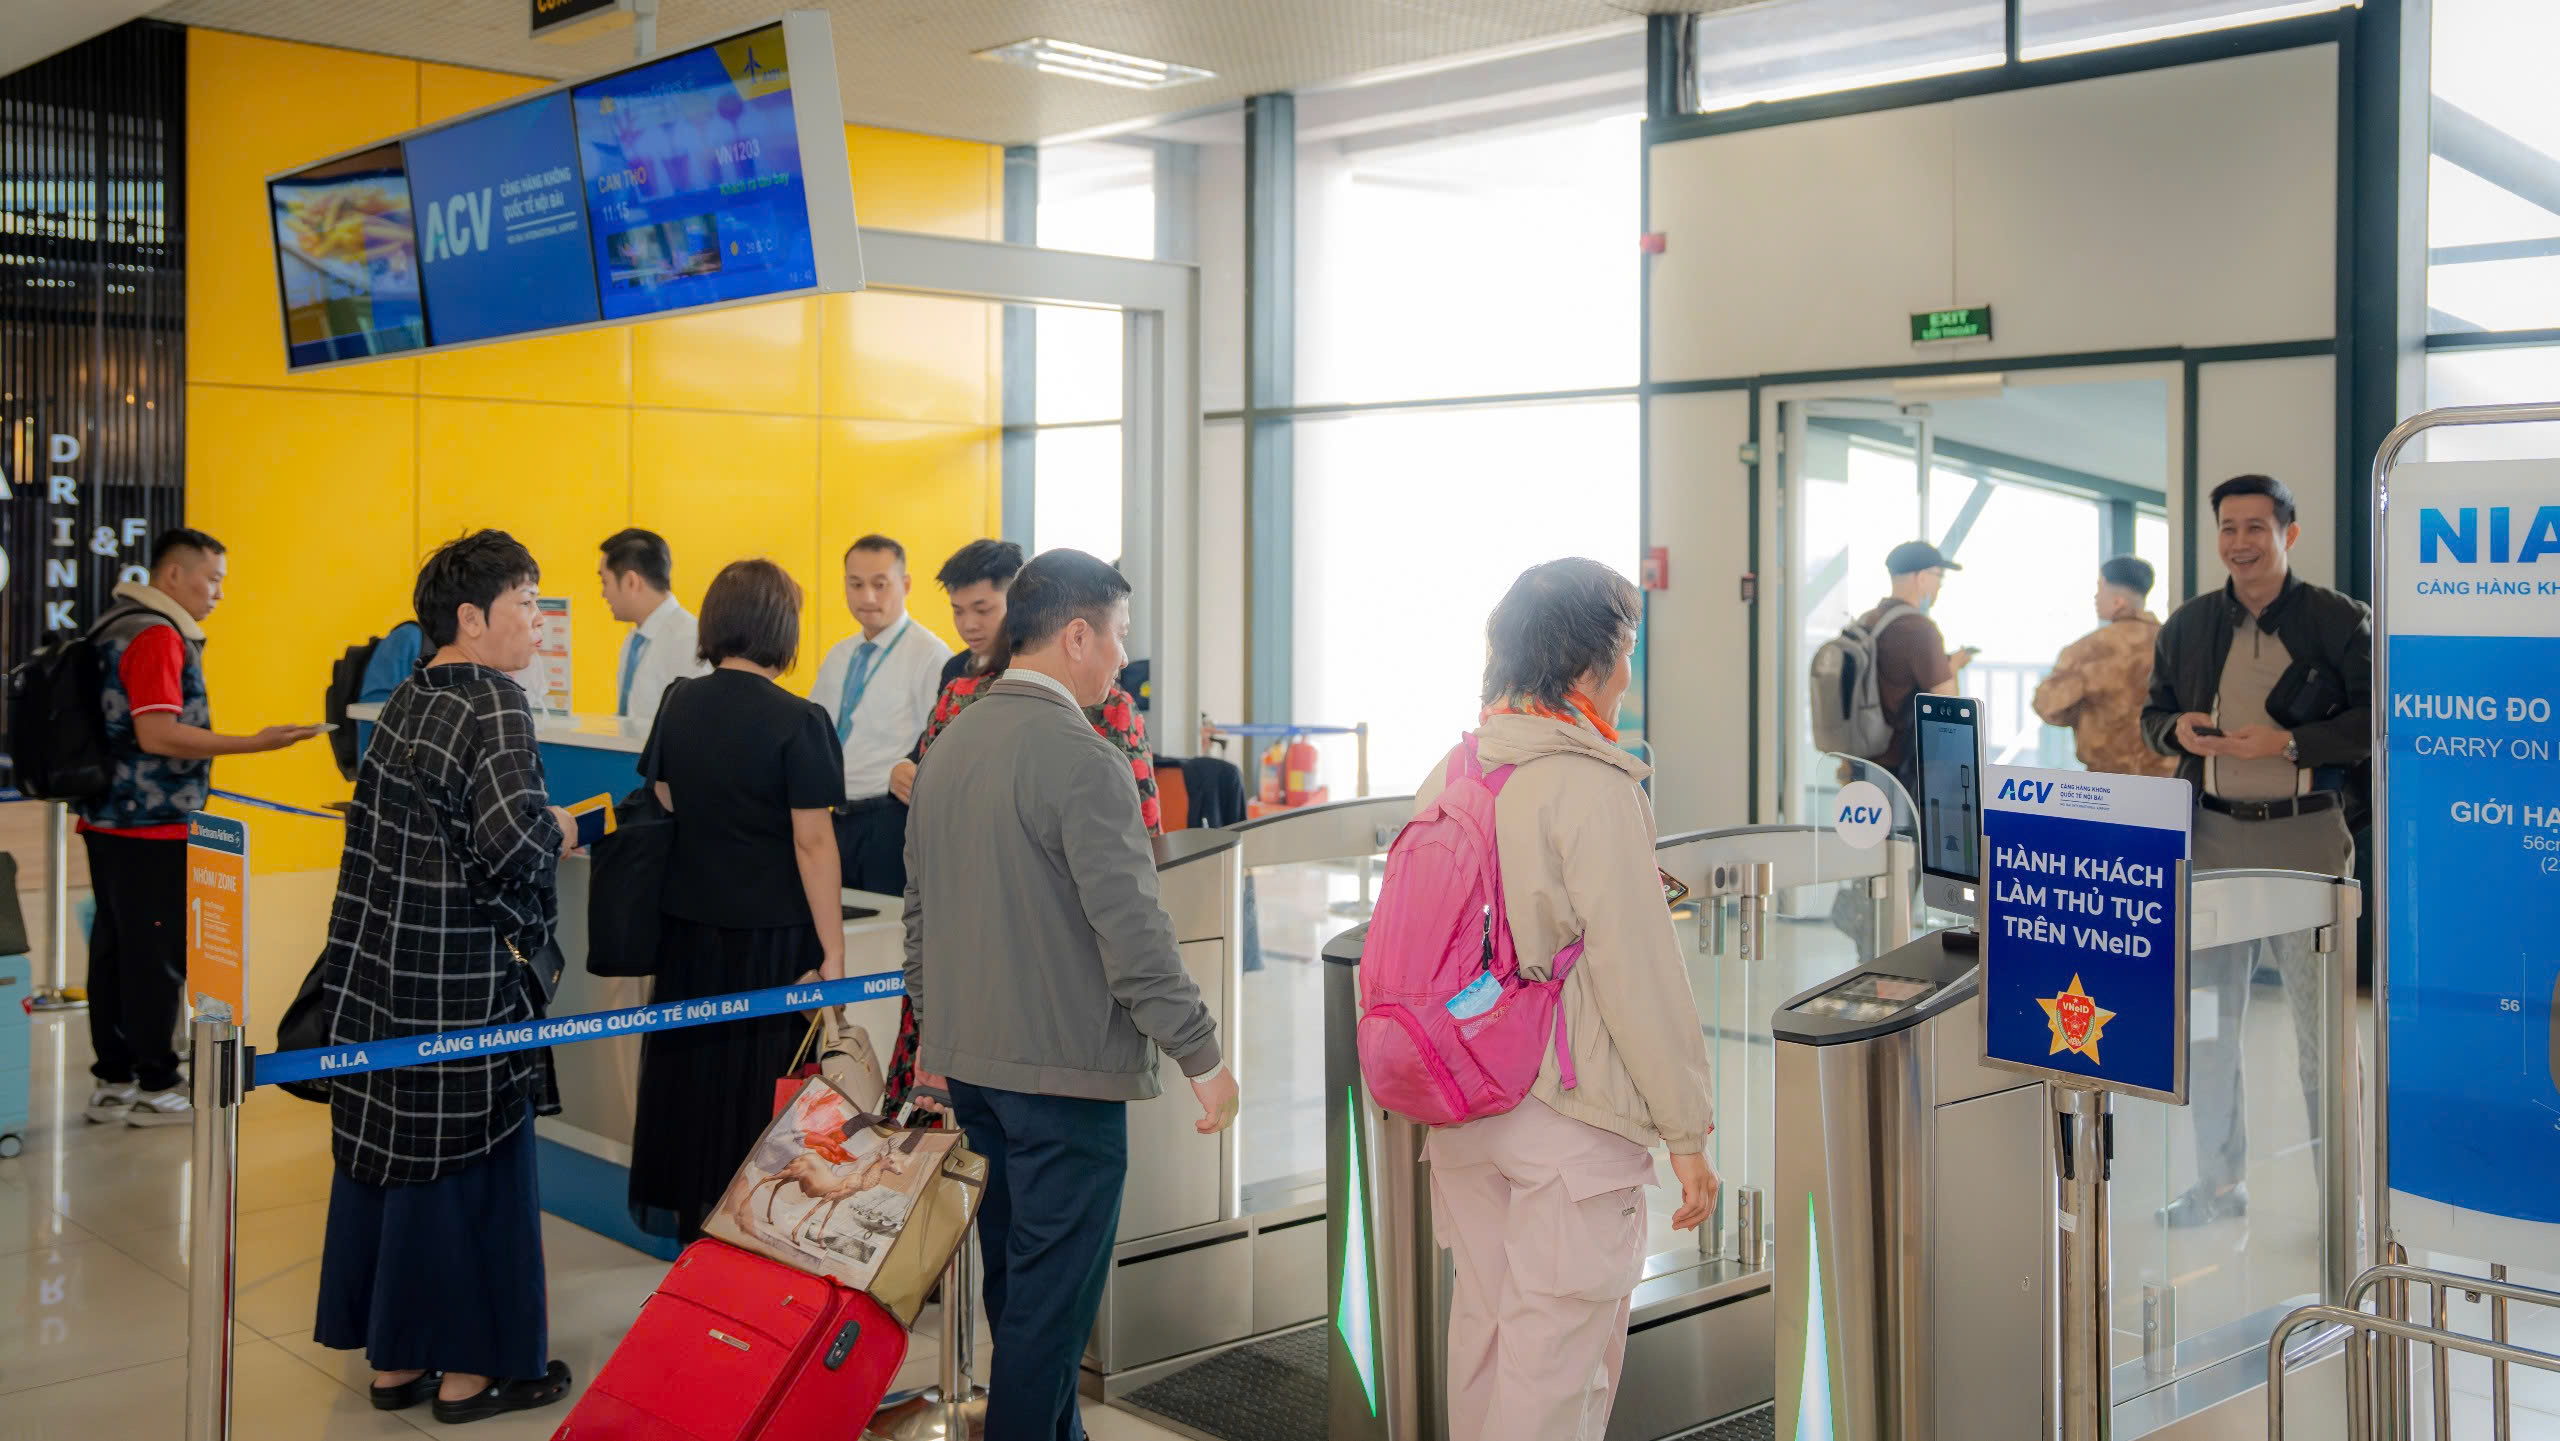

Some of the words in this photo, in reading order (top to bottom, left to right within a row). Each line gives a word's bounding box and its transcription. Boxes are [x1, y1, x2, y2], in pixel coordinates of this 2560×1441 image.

[425, 187, 492, 263] ACV
[1929, 310, 1969, 328] EXIT
[45, 434, 81, 631] DRINK
[89, 526, 119, 557] &
[2420, 505, 2560, 563] NIA
[2476, 577, 2531, 595] HÀNG
[2394, 693, 2497, 721] KHUNG
[2506, 697, 2550, 723] ĐO
[2415, 735, 2503, 758] CARRY
[2510, 739, 2549, 761] ON
[1997, 778, 2054, 804] ACV
[1838, 804, 1882, 825] ACV
[2451, 797, 2513, 825] GIỚI
[1996, 843, 2066, 876] HÀNH
[2074, 856, 2163, 889] KHÁCH
[217, 872, 237, 893] ZONE
[1996, 877, 2047, 908] LÀM
[2053, 886, 2104, 916] THỦ
[2110, 896, 2163, 928] TỤC
[192, 896, 201, 949] 1
[2002, 915, 2066, 945] TRÊN
[2072, 926, 2151, 958] VNeID
[2062, 1001, 2090, 1014] VNeID
[2500, 998, 2521, 1012] 56
[320, 1050, 369, 1070] N.I.A
[418, 1035, 474, 1057] CẢNG
[479, 1026, 533, 1049] HÀNG
[538, 1017, 602, 1040] KHÔNG
[607, 1006, 658, 1030] QUỐC
[662, 1002, 685, 1023] TẾ
[687, 999, 717, 1019] NỘI
